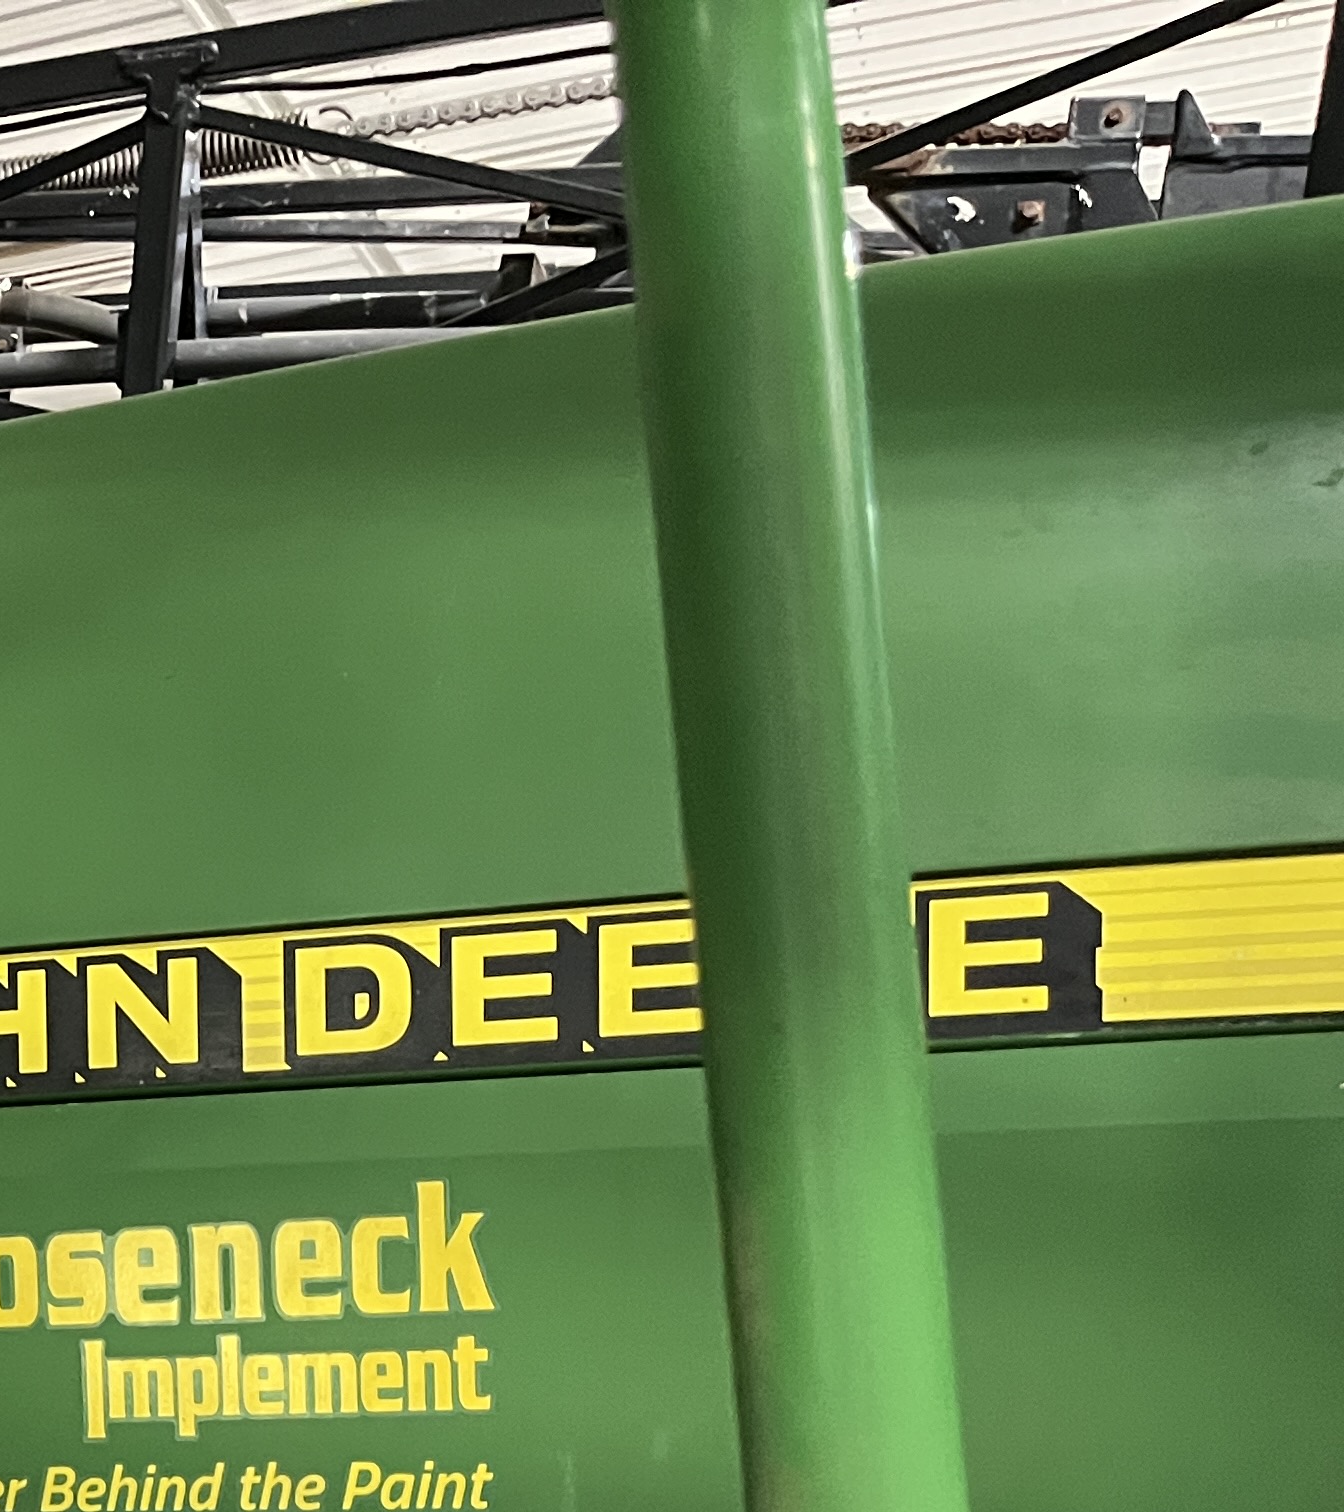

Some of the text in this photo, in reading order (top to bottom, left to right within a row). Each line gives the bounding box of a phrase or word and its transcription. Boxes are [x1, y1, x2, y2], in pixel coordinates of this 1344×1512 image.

[296, 890, 1051, 1059] DEEE
[85, 1334, 493, 1440] Implement
[240, 1461, 326, 1512] the
[342, 1459, 494, 1511] Paint
